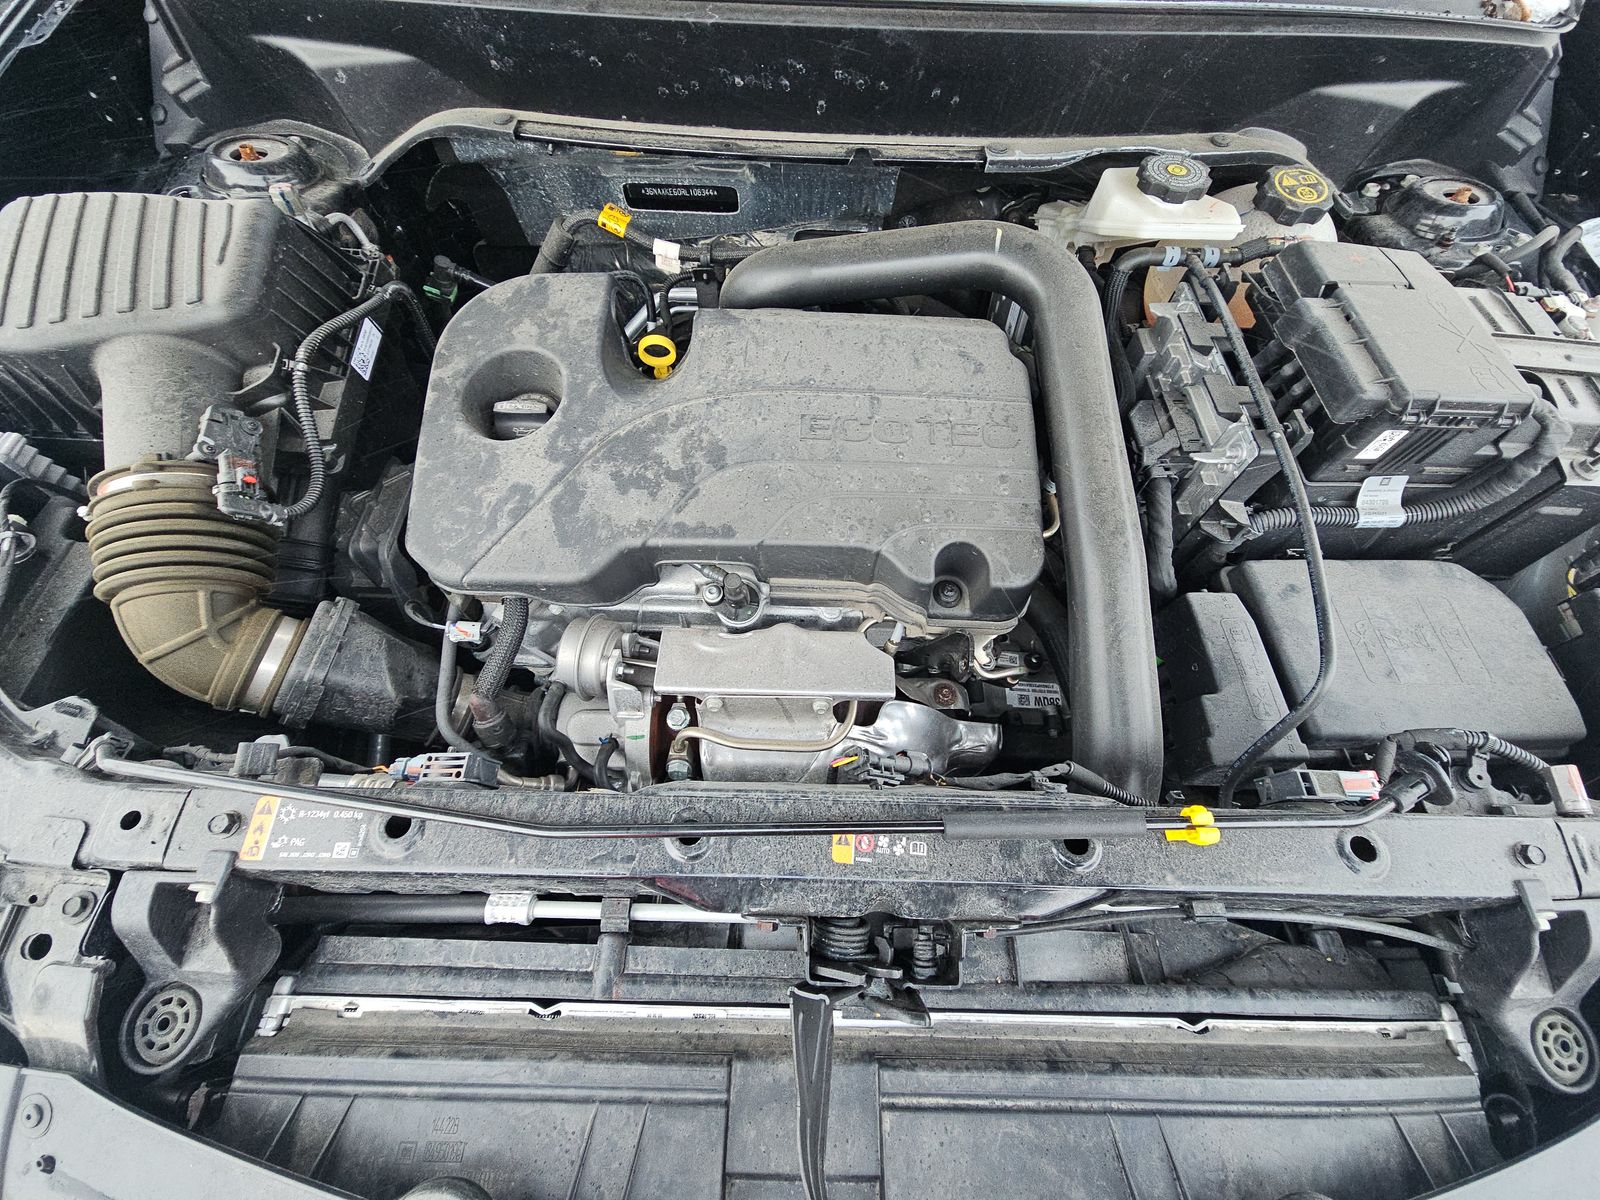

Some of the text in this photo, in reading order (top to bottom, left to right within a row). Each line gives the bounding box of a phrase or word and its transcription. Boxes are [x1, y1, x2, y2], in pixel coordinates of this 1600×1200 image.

[799, 413, 1021, 449] ECOTEC
[353, 811, 363, 819] kg
[290, 838, 305, 846] PAG
